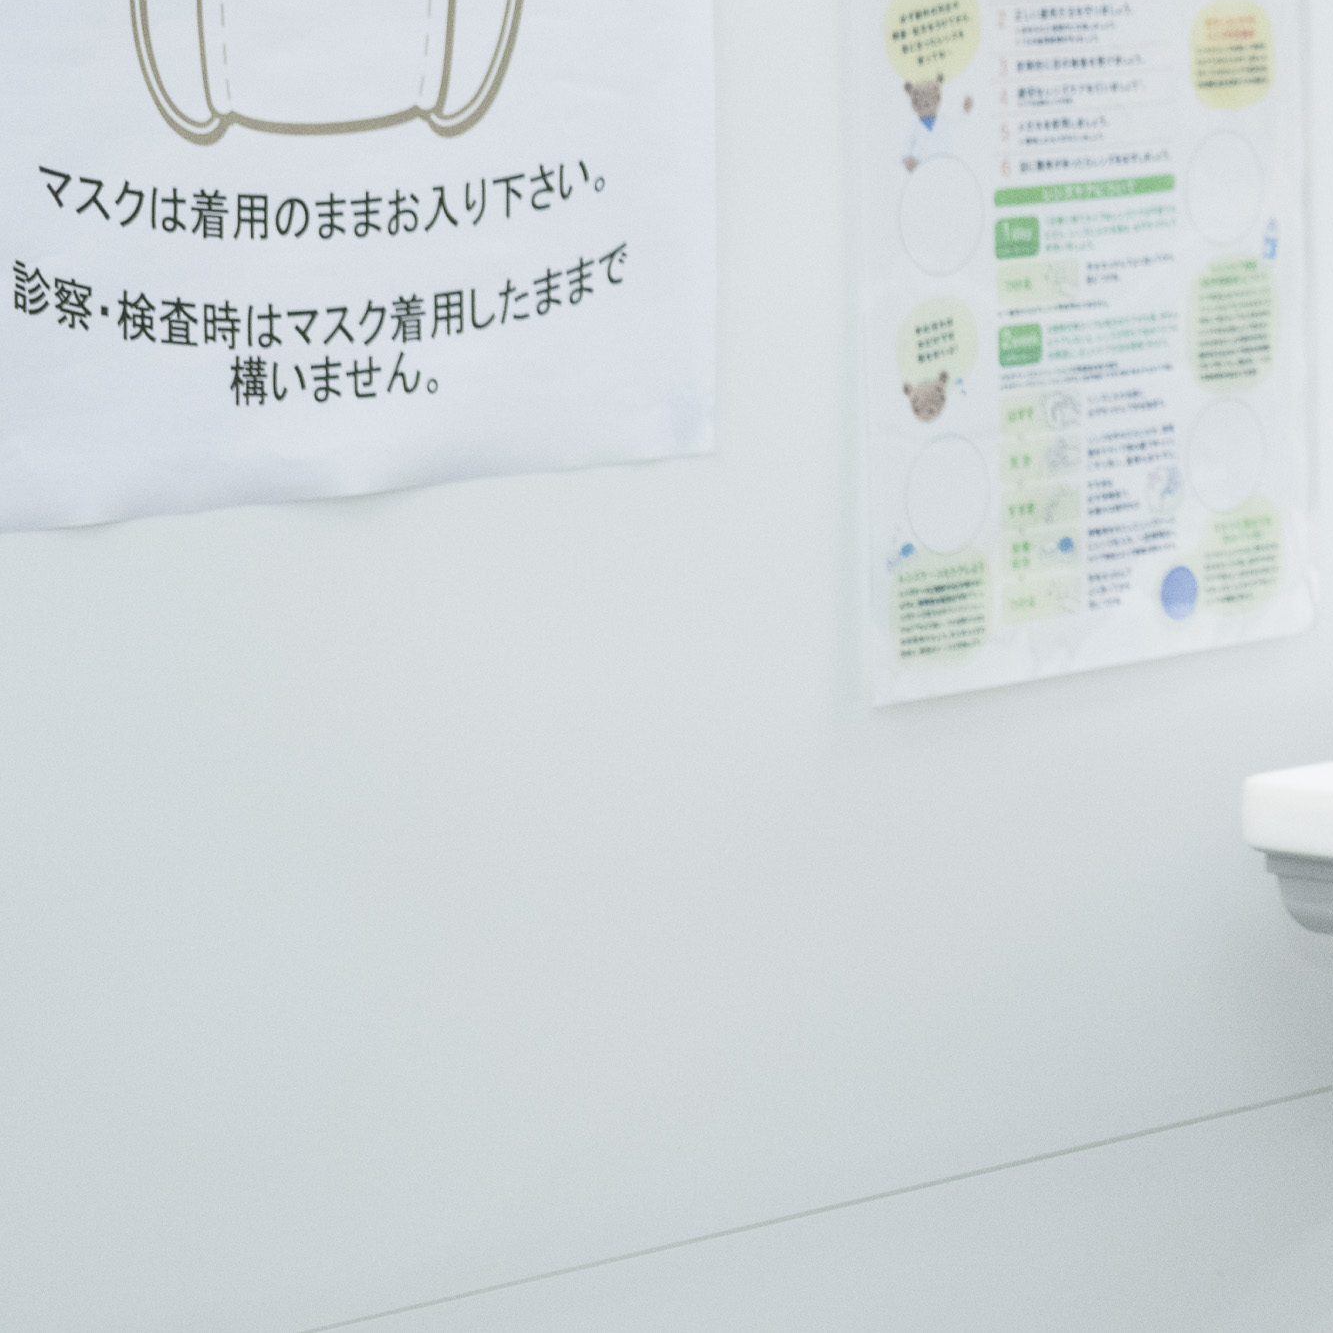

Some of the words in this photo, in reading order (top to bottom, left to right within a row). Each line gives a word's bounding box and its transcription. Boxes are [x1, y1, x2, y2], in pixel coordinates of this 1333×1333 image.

[38, 159, 607, 240] マスクは着用のままお入り下さい。
[12, 242, 628, 350] 診察・検査時はマスク着用したままで
[230, 354, 439, 406] 構いません。
